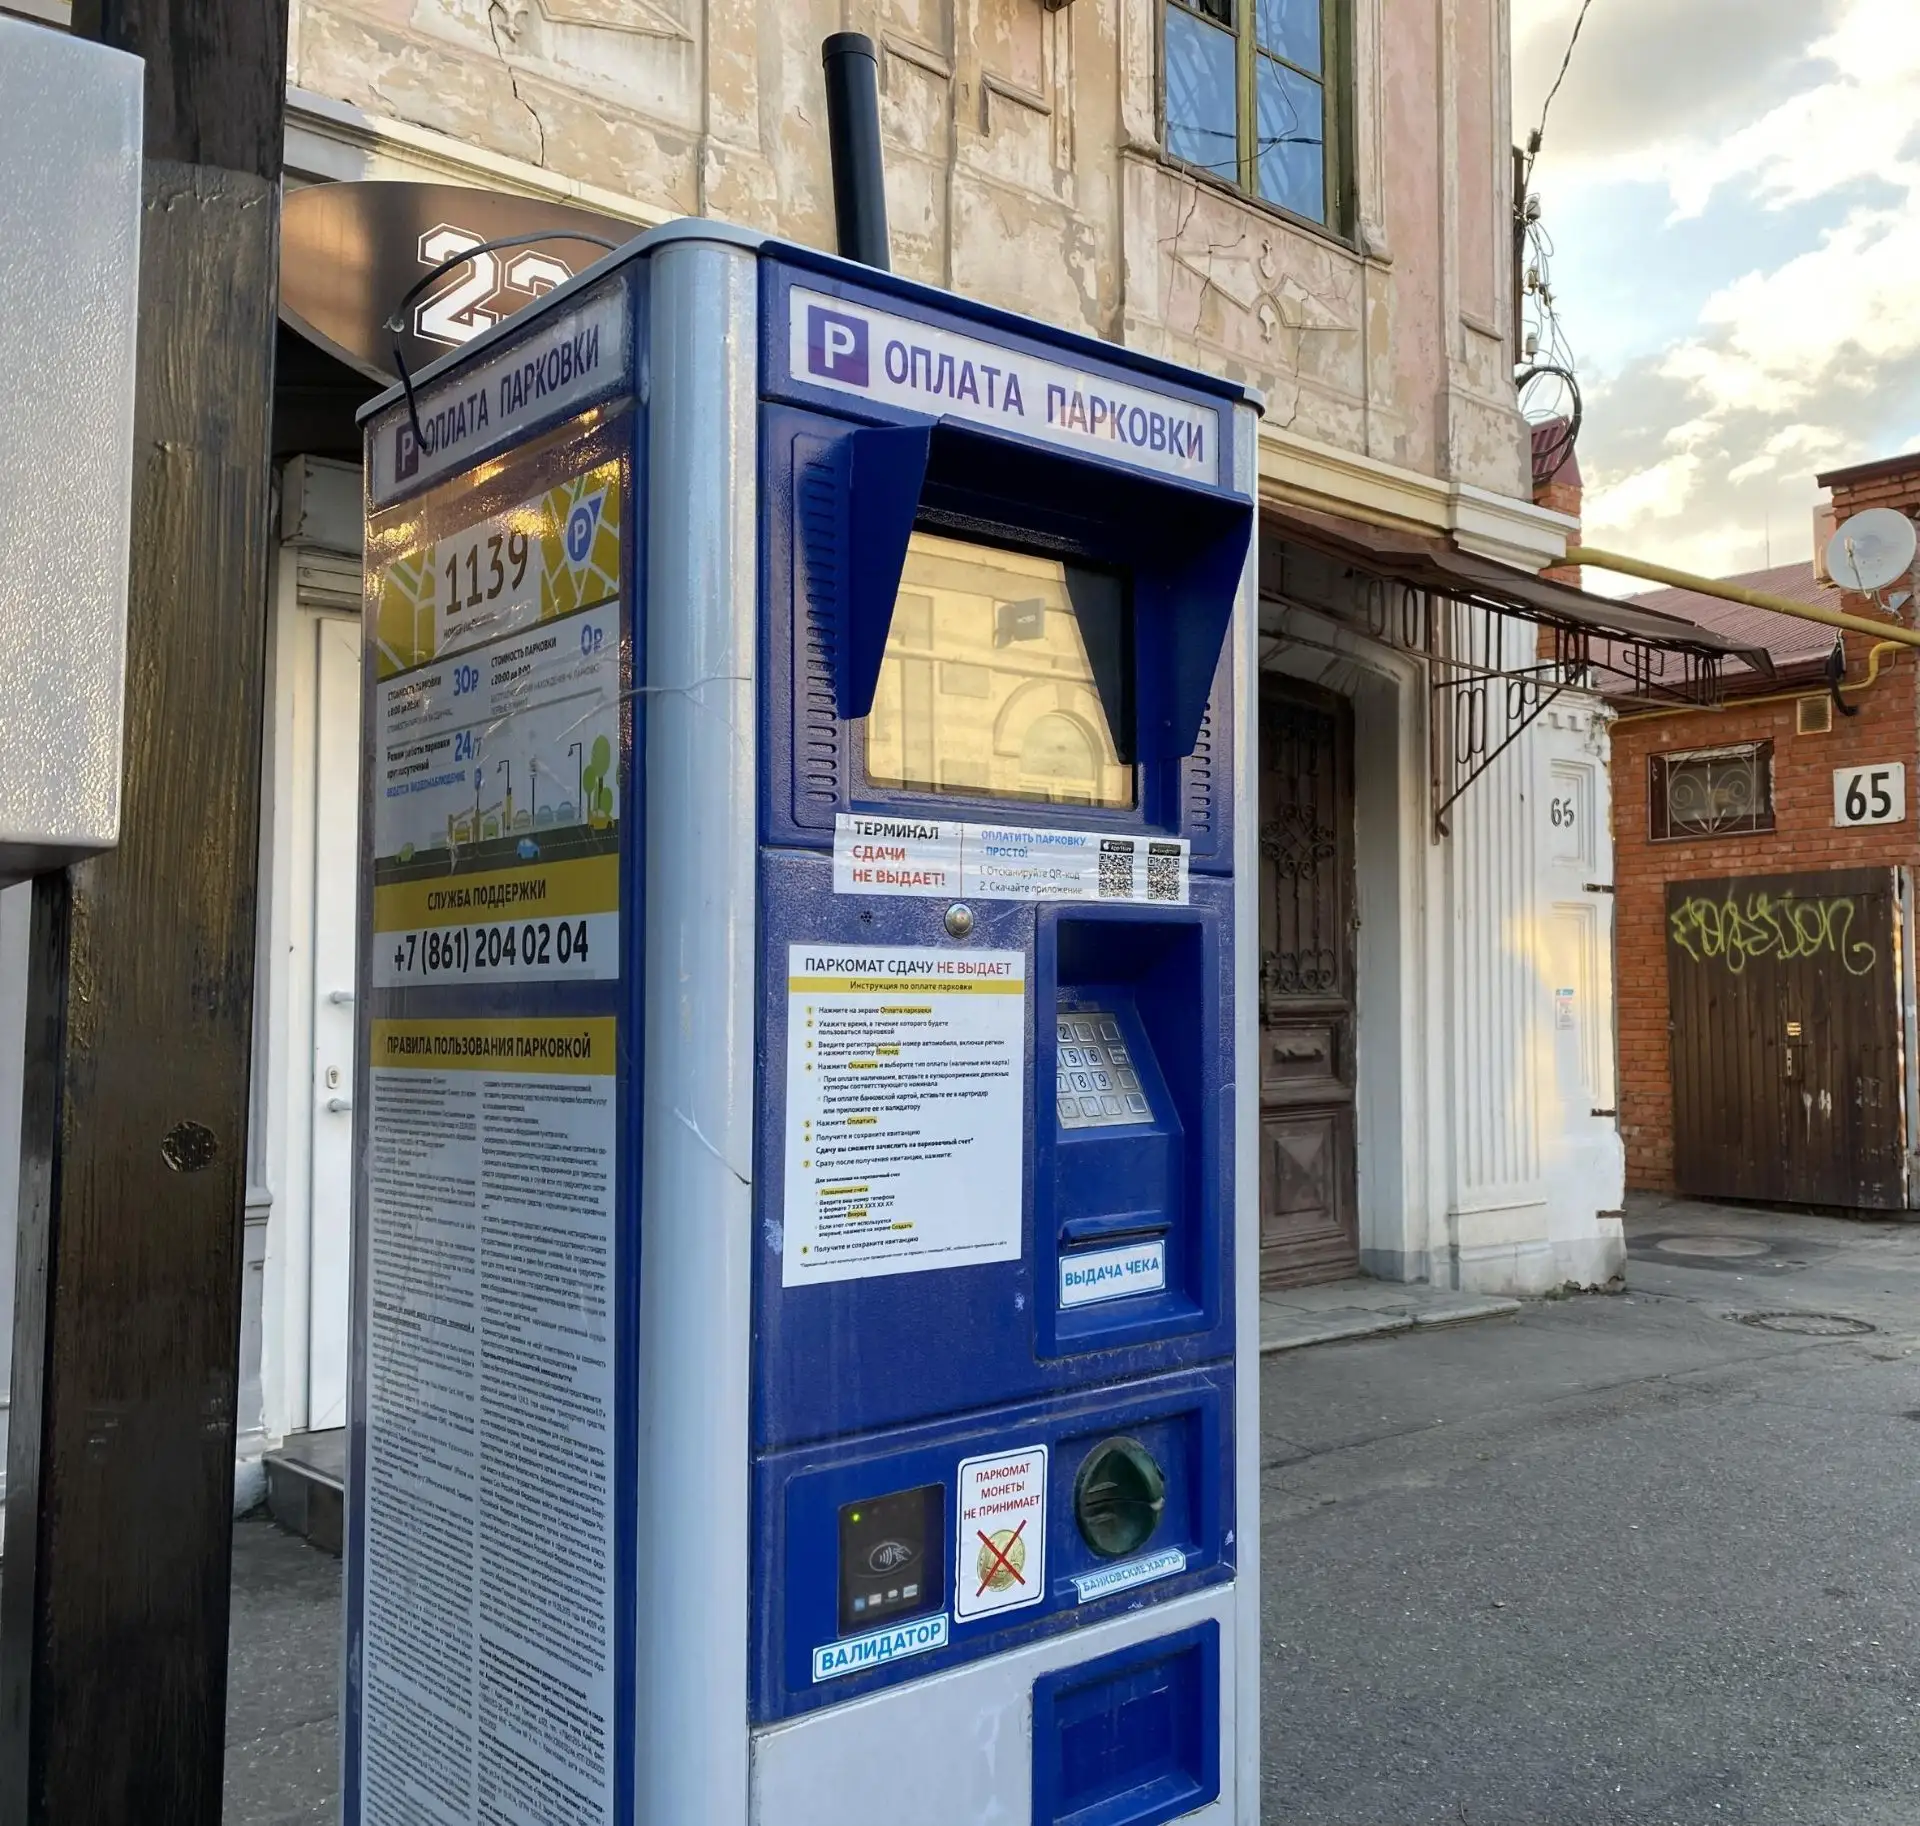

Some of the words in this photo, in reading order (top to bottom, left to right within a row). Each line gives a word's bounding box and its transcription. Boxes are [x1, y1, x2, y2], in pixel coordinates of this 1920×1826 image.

[425, 389, 488, 456] ОПЛАТА
[500, 325, 599, 418] ПАРКОВКИ
[824, 321, 855, 369] P
[885, 340, 1024, 416] ОПЛАТА
[1047, 384, 1203, 462] ПАРКОВКИ
[445, 532, 528, 616] 1139
[491, 650, 524, 668] СТОИМОСТЬ
[525, 637, 557, 657] ПАРКОВКИ
[455, 730, 482, 762] 24/7
[1845, 772, 1891, 821] 65
[1551, 798, 1575, 828] 65
[854, 821, 939, 840] ТЕРМИНАЛ
[982, 830, 1034, 843] ОПЛАТИТЬ
[1036, 834, 1086, 846] ПАРКОВКУ
[853, 845, 906, 862] СДАЧИ
[986, 846, 1028, 858] ПРОСТО!
[852, 870, 872, 882] НЕ
[876, 870, 945, 888] ВЫДАЕТ!
[987, 866, 1048, 880] Отсканируйте
[1050, 869, 1080, 880] QR-код
[428, 889, 471, 911] СЛУЖБА
[473, 879, 546, 908] ПОДДЕРЖКИ
[980, 882, 988, 891] 2.
[990, 882, 1030, 892] Скачайте
[1032, 886, 1082, 896] приложение
[395, 934, 416, 972] +7
[422, 927, 469, 975] (861)
[475, 926, 516, 967] 204
[522, 923, 550, 965] 02
[557, 920, 589, 964] 04
[805, 957, 885, 973] ПАРКОМАТ
[887, 960, 934, 976] СДАЧУ
[937, 962, 954, 974] НЕ
[957, 962, 1012, 977] ВЫДАЕТ
[850, 980, 898, 992] Инструкция
[1060, 1027, 1070, 1040] 2
[387, 1036, 432, 1055] ПРАВИЛА
[435, 1037, 513, 1057] ПОЛЬЗОВАНИЯ
[517, 1032, 591, 1059] ПАРКОВКОЙ
[1069, 1051, 1076, 1064] 5
[1090, 1050, 1098, 1062] 6
[1078, 1075, 1086, 1088] 8
[1099, 1074, 1107, 1087] 9
[816, 1146, 836, 1154] Сдачу
[1065, 1264, 1123, 1286] ВЫДАЧА
[1125, 1257, 1160, 1275] ЧЕКА
[976, 1463, 1031, 1483] ПАРКОМАТ
[981, 1480, 1025, 1500] МОНЕТЫ
[964, 1508, 976, 1520] НЕ
[979, 1495, 1041, 1517] ПРИНИМАЕТ
[1083, 1565, 1147, 1592] БАНКОВСКИЕ
[1148, 1553, 1181, 1572] КАРТЫ
[822, 1622, 941, 1672] ВАЛИДАТОР
